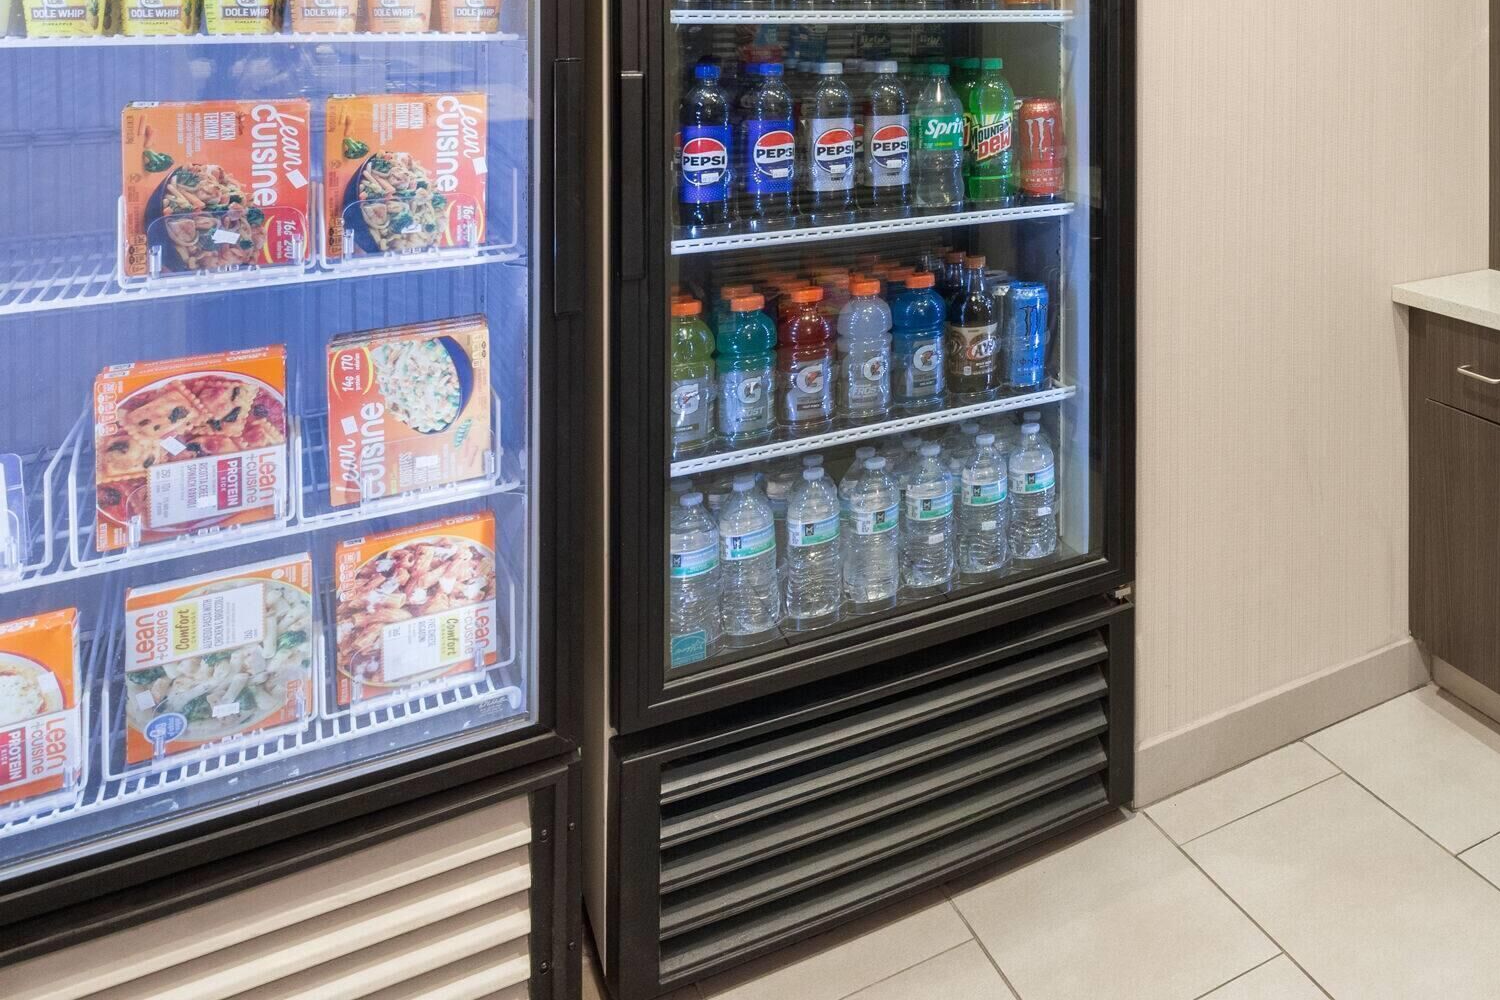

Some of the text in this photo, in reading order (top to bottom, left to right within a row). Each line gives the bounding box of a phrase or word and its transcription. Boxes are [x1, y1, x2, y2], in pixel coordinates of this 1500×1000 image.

[33, 9, 85, 18] DOLE WHIP
[131, 9, 179, 18] DOLE WHIP
[279, 113, 305, 171] Lean
[459, 104, 483, 158] Lean
[683, 156, 726, 166] PEPSI
[342, 354, 353, 371] 170
[227, 460, 240, 506] PROTEIN
[259, 452, 277, 501] Lean
[336, 437, 361, 494] Lean
[135, 613, 155, 664] Lean
[175, 609, 190, 651] Comfort
[446, 618, 459, 656] Comfort
[475, 606, 490, 649] Lean
[10, 728, 22, 779] PROTEIN
[46, 717, 67, 770] Lean
